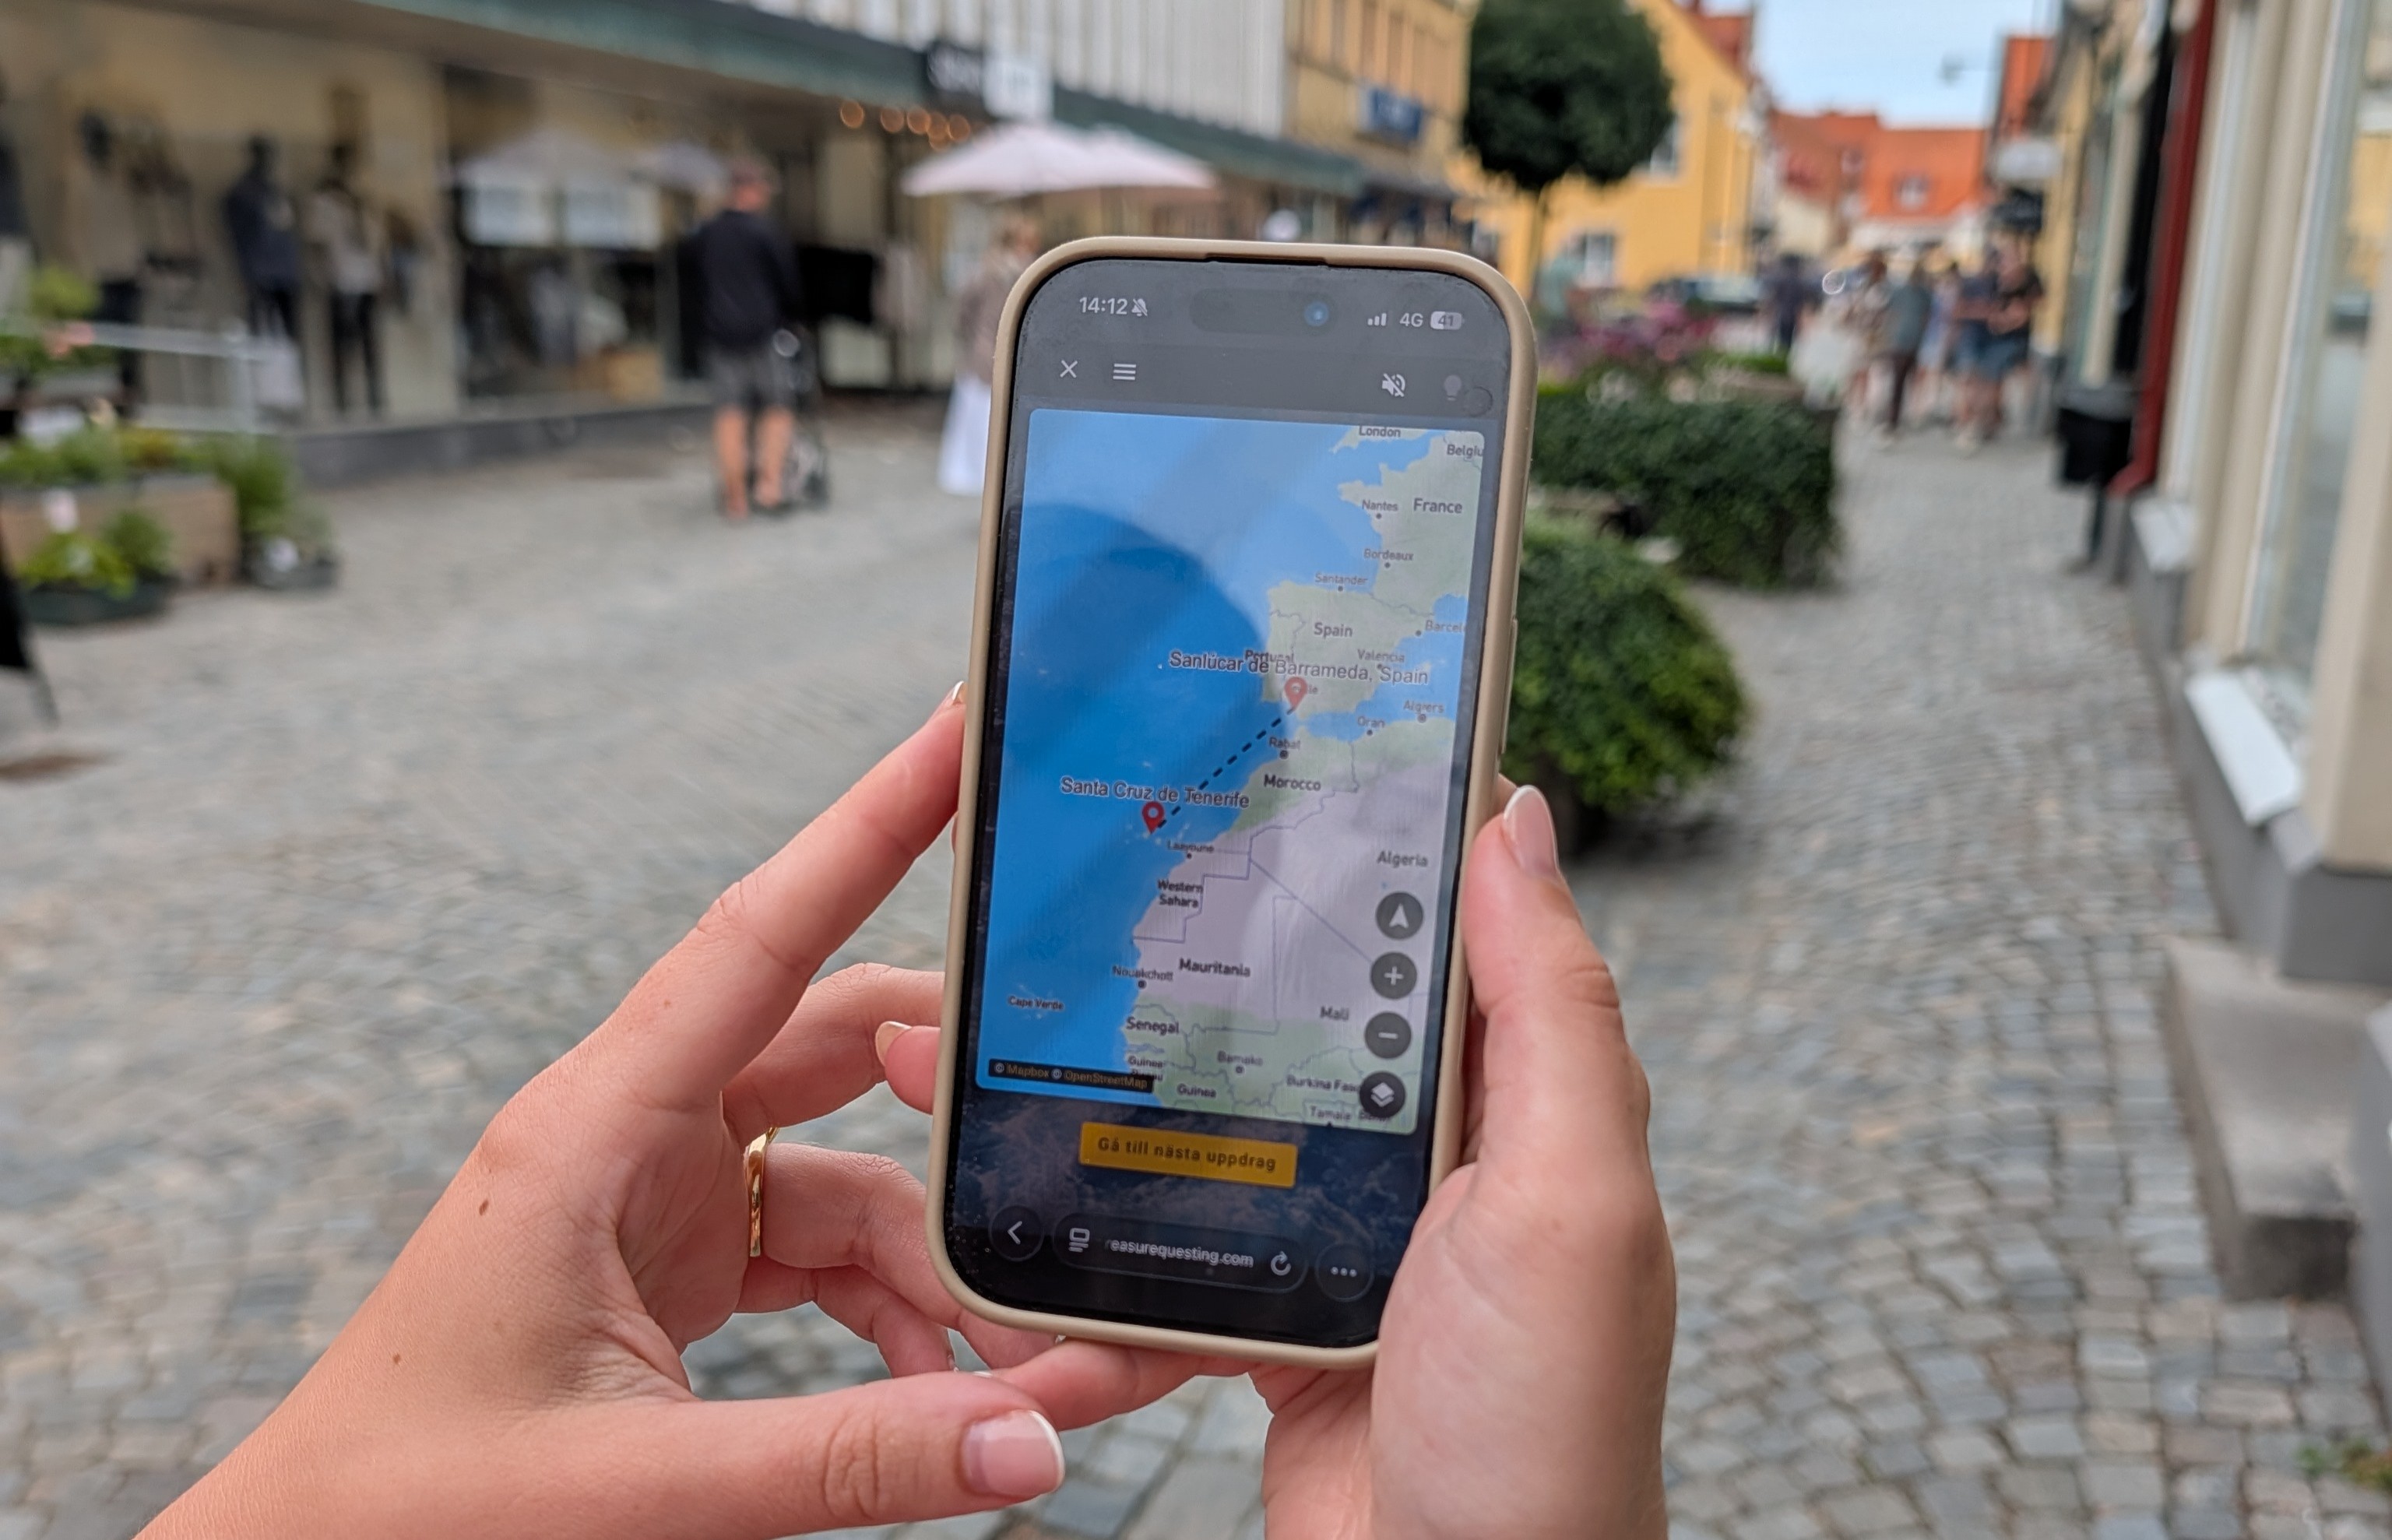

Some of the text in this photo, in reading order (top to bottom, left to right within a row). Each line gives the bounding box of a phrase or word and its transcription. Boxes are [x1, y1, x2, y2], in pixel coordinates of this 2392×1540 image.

[1079, 297, 1128, 315] 14:12
[1399, 313, 1455, 327] 4G 41
[1359, 425, 1401, 438] London
[1363, 499, 1398, 512] Nantes
[1413, 498, 1462, 514] France
[1364, 548, 1413, 561] Bordeaux
[1315, 573, 1367, 586] Santander
[1314, 621, 1353, 638] Spain
[1170, 651, 1429, 685] Sanlúcar de Barrameda, Spain
[1358, 716, 1385, 728] Oran
[1269, 736, 1300, 750] Rabat
[1264, 775, 1321, 792] Morocco
[1061, 777, 1250, 808] Santa Cruz de Tenerife
[1377, 850, 1428, 868] Algeria
[1158, 880, 1204, 894] Western
[1159, 894, 1199, 909] Sahara
[1179, 957, 1251, 977] Mauritania
[1008, 995, 1064, 1011] Cape Verde
[1320, 1005, 1349, 1021] Mali
[1127, 1016, 1180, 1035] Senegal
[1217, 1050, 1263, 1067] Bamako
[1007, 1064, 1050, 1078] Mapbox
[1064, 1070, 1148, 1090] OpenStreetMap
[1286, 1074, 1332, 1090] Burkina
[1177, 1083, 1217, 1099] Guinea
[1310, 1106, 1351, 1121] Tamale
[1098, 1137, 1276, 1172] Gå till nästa uppdrag
